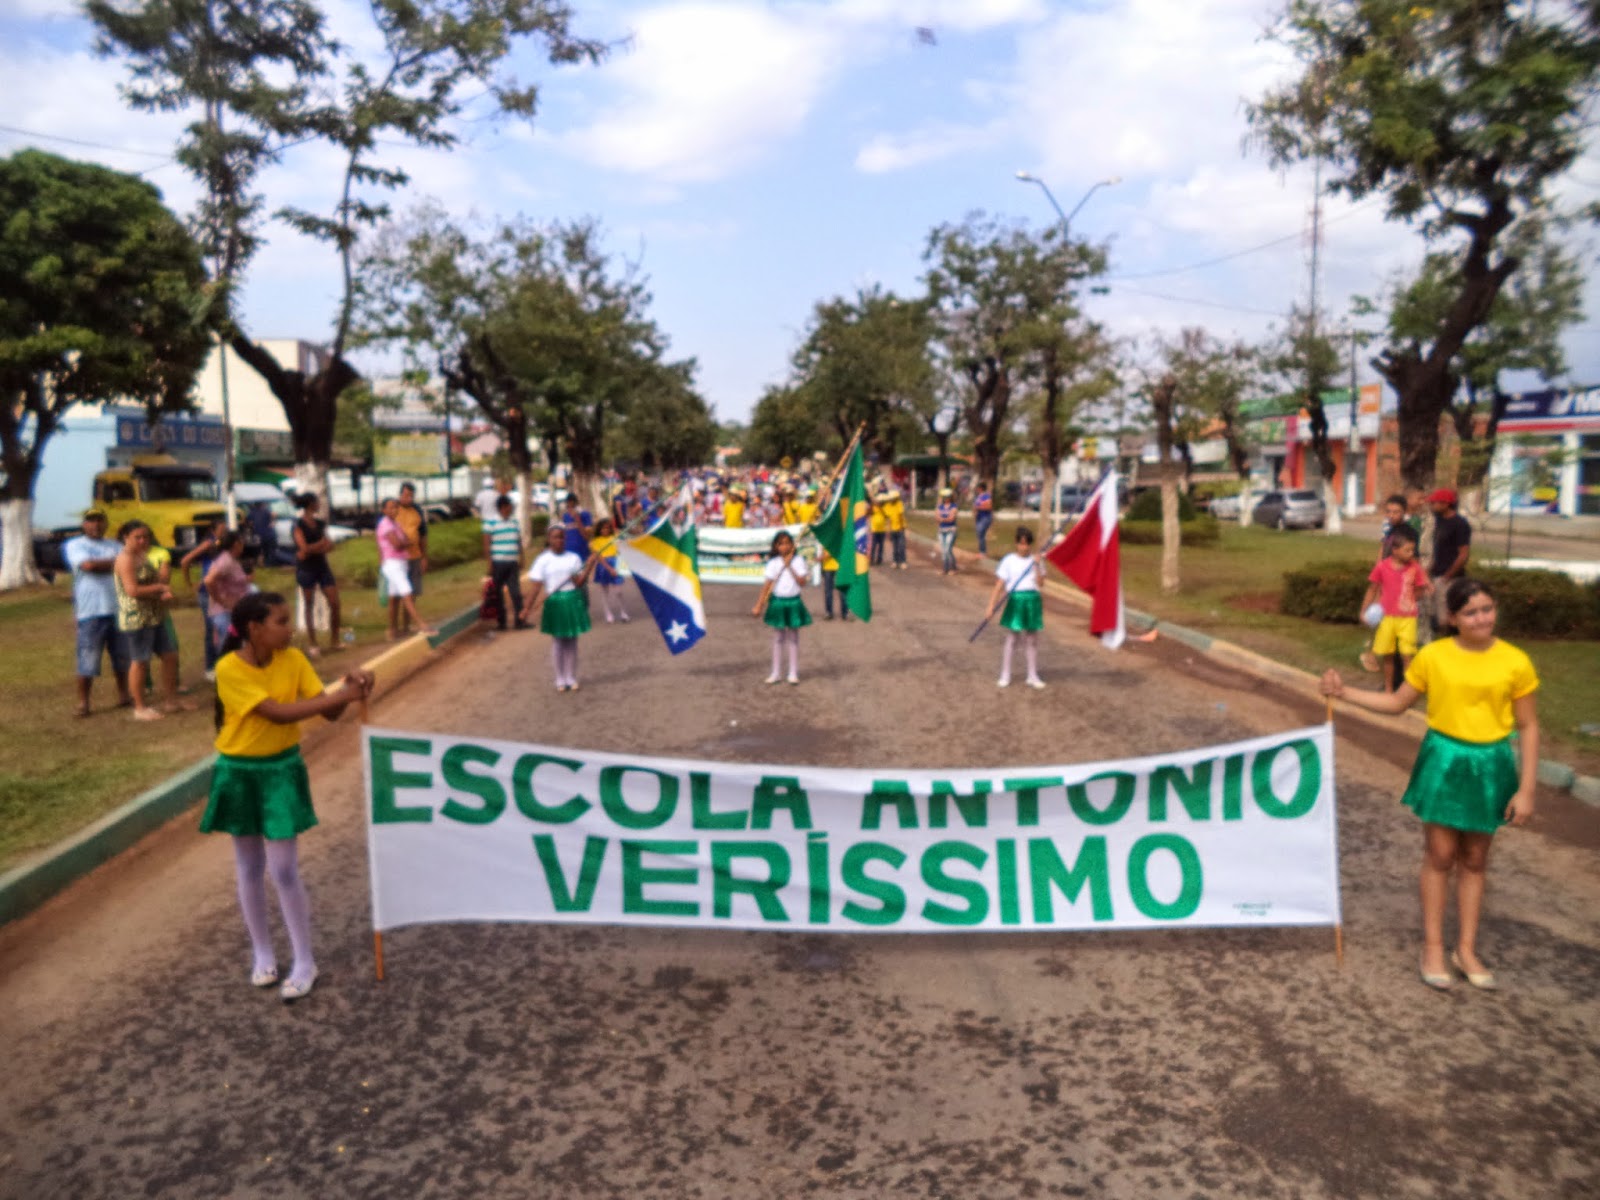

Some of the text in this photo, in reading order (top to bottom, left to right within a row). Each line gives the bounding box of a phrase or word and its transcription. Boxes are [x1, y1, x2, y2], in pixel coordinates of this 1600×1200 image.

[370, 737, 1322, 830] ESCOLA ANTONIO
[533, 831, 1203, 926] VERÍSSIMO
